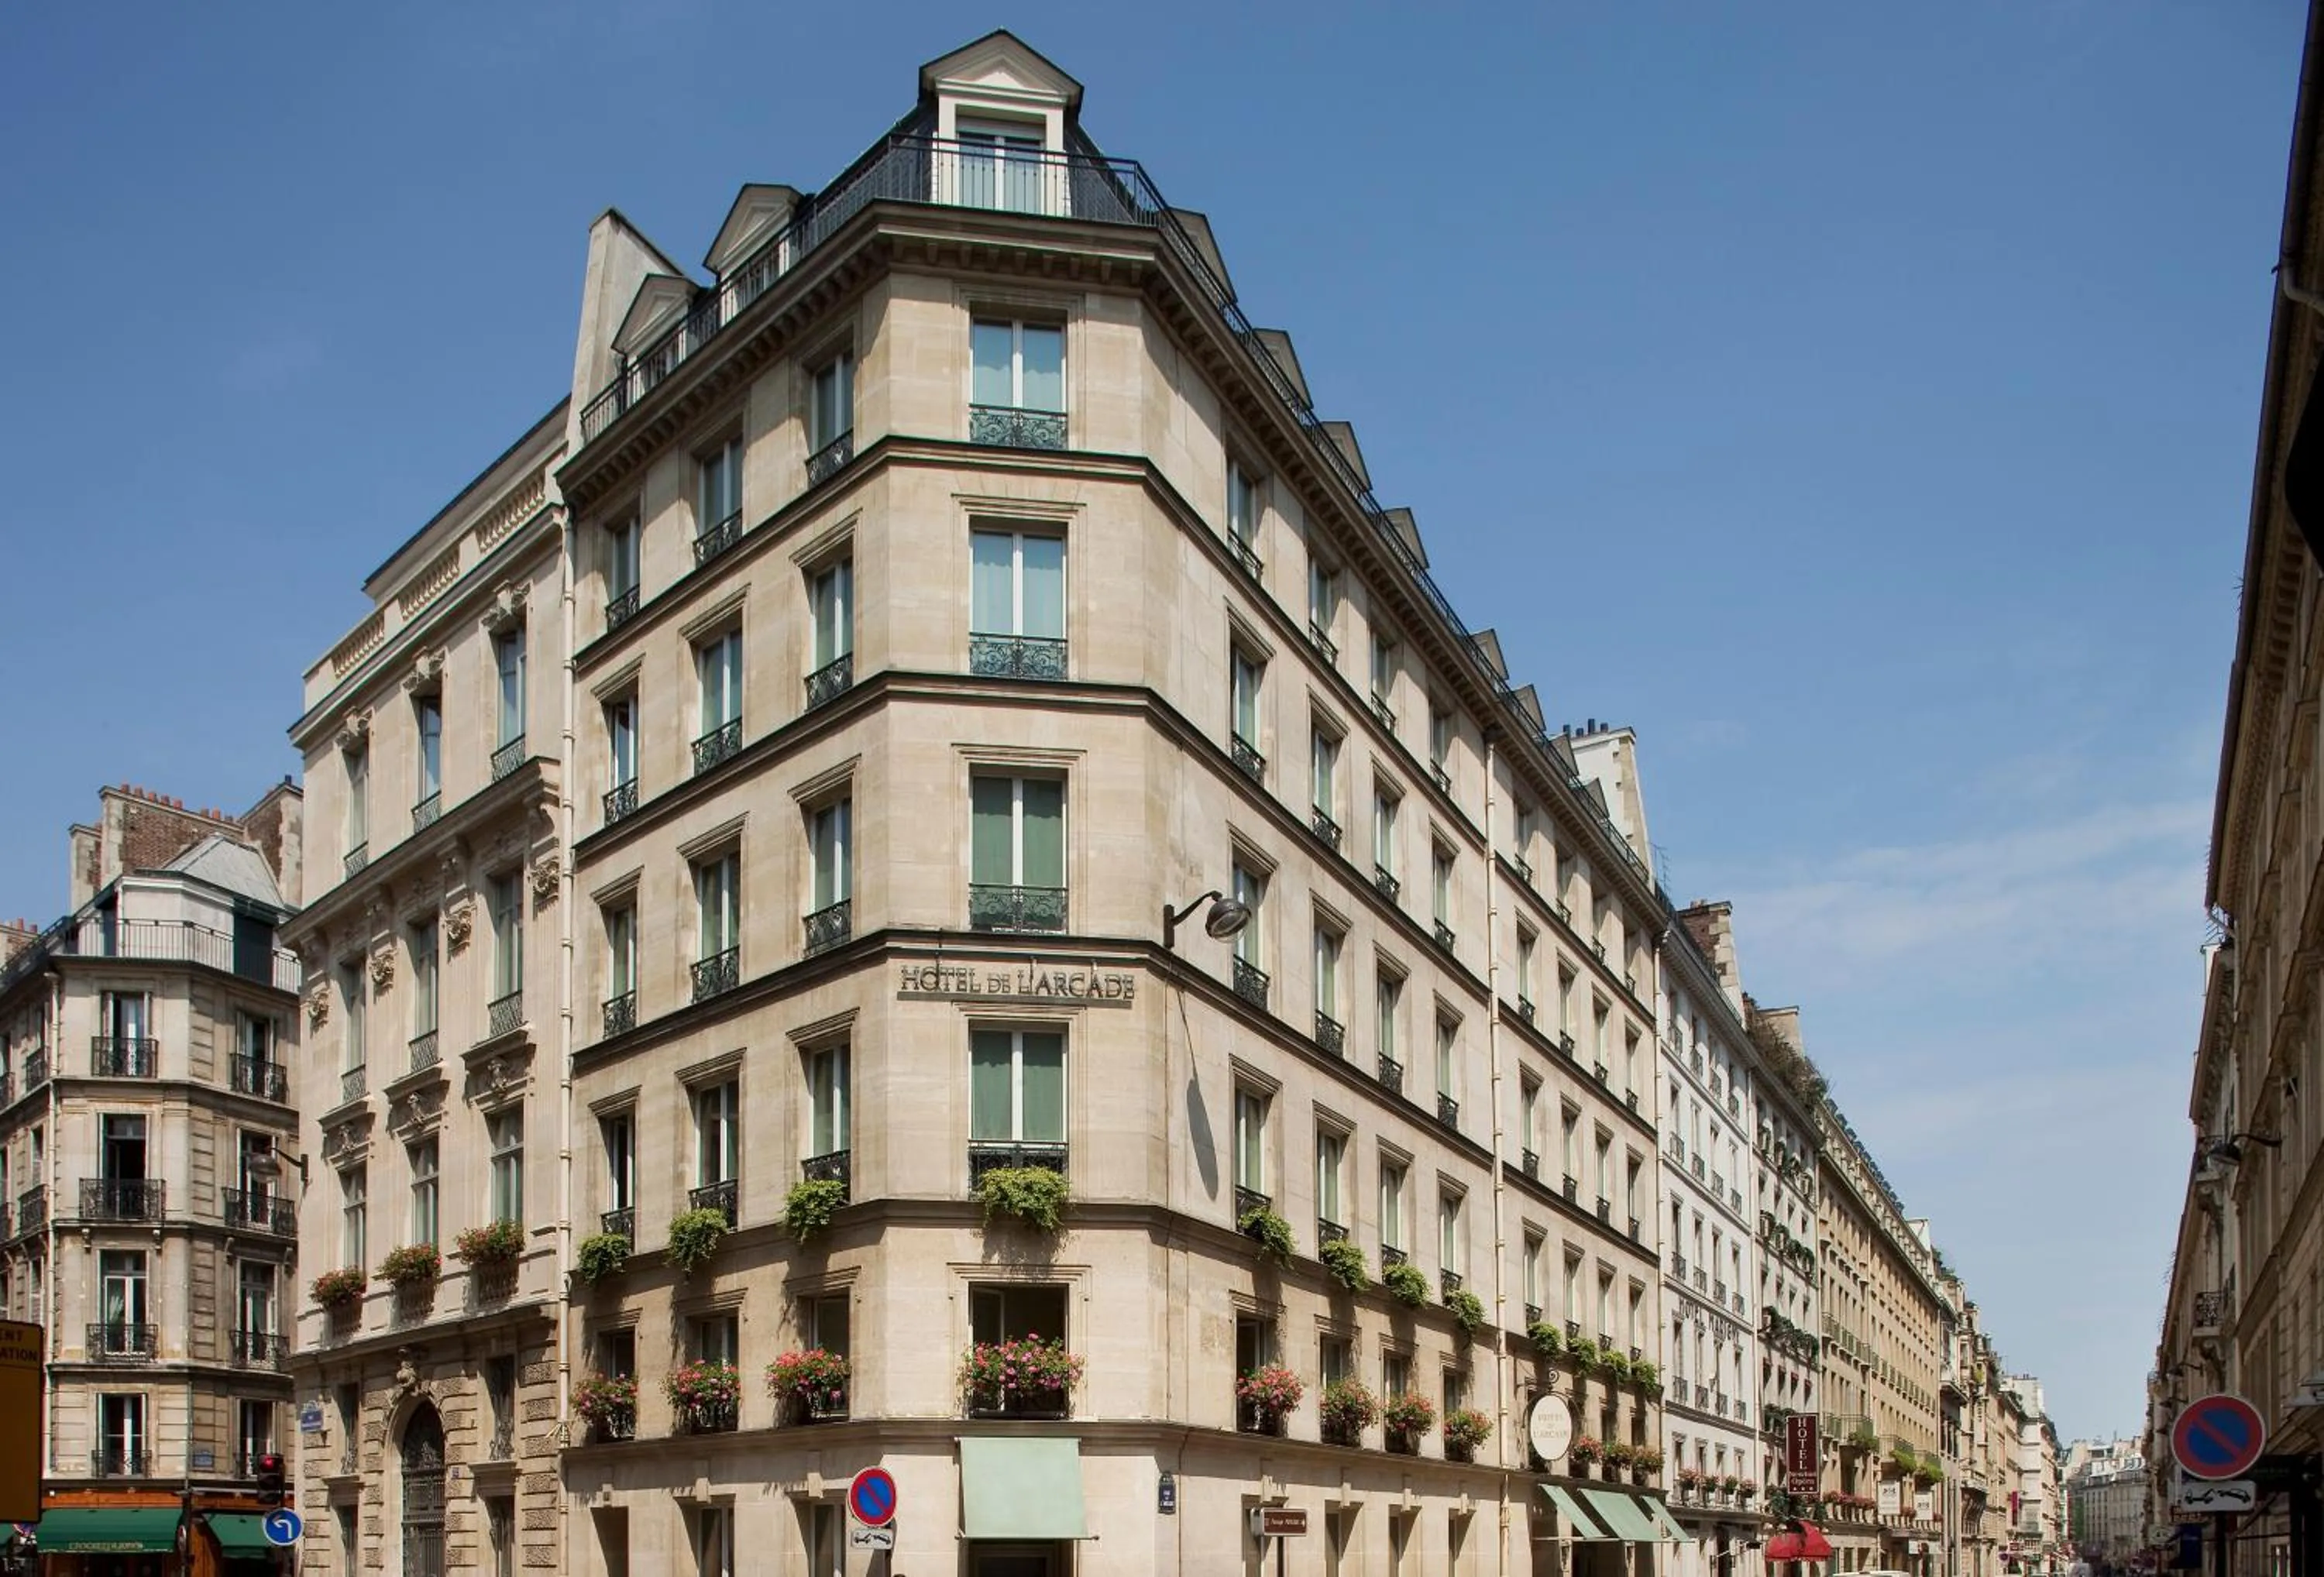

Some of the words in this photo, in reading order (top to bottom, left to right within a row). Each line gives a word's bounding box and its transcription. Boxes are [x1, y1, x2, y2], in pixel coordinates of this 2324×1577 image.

[901, 965, 981, 992] HOTEL
[986, 971, 1011, 994] DE
[1798, 1417, 1807, 1469] HOTEL
